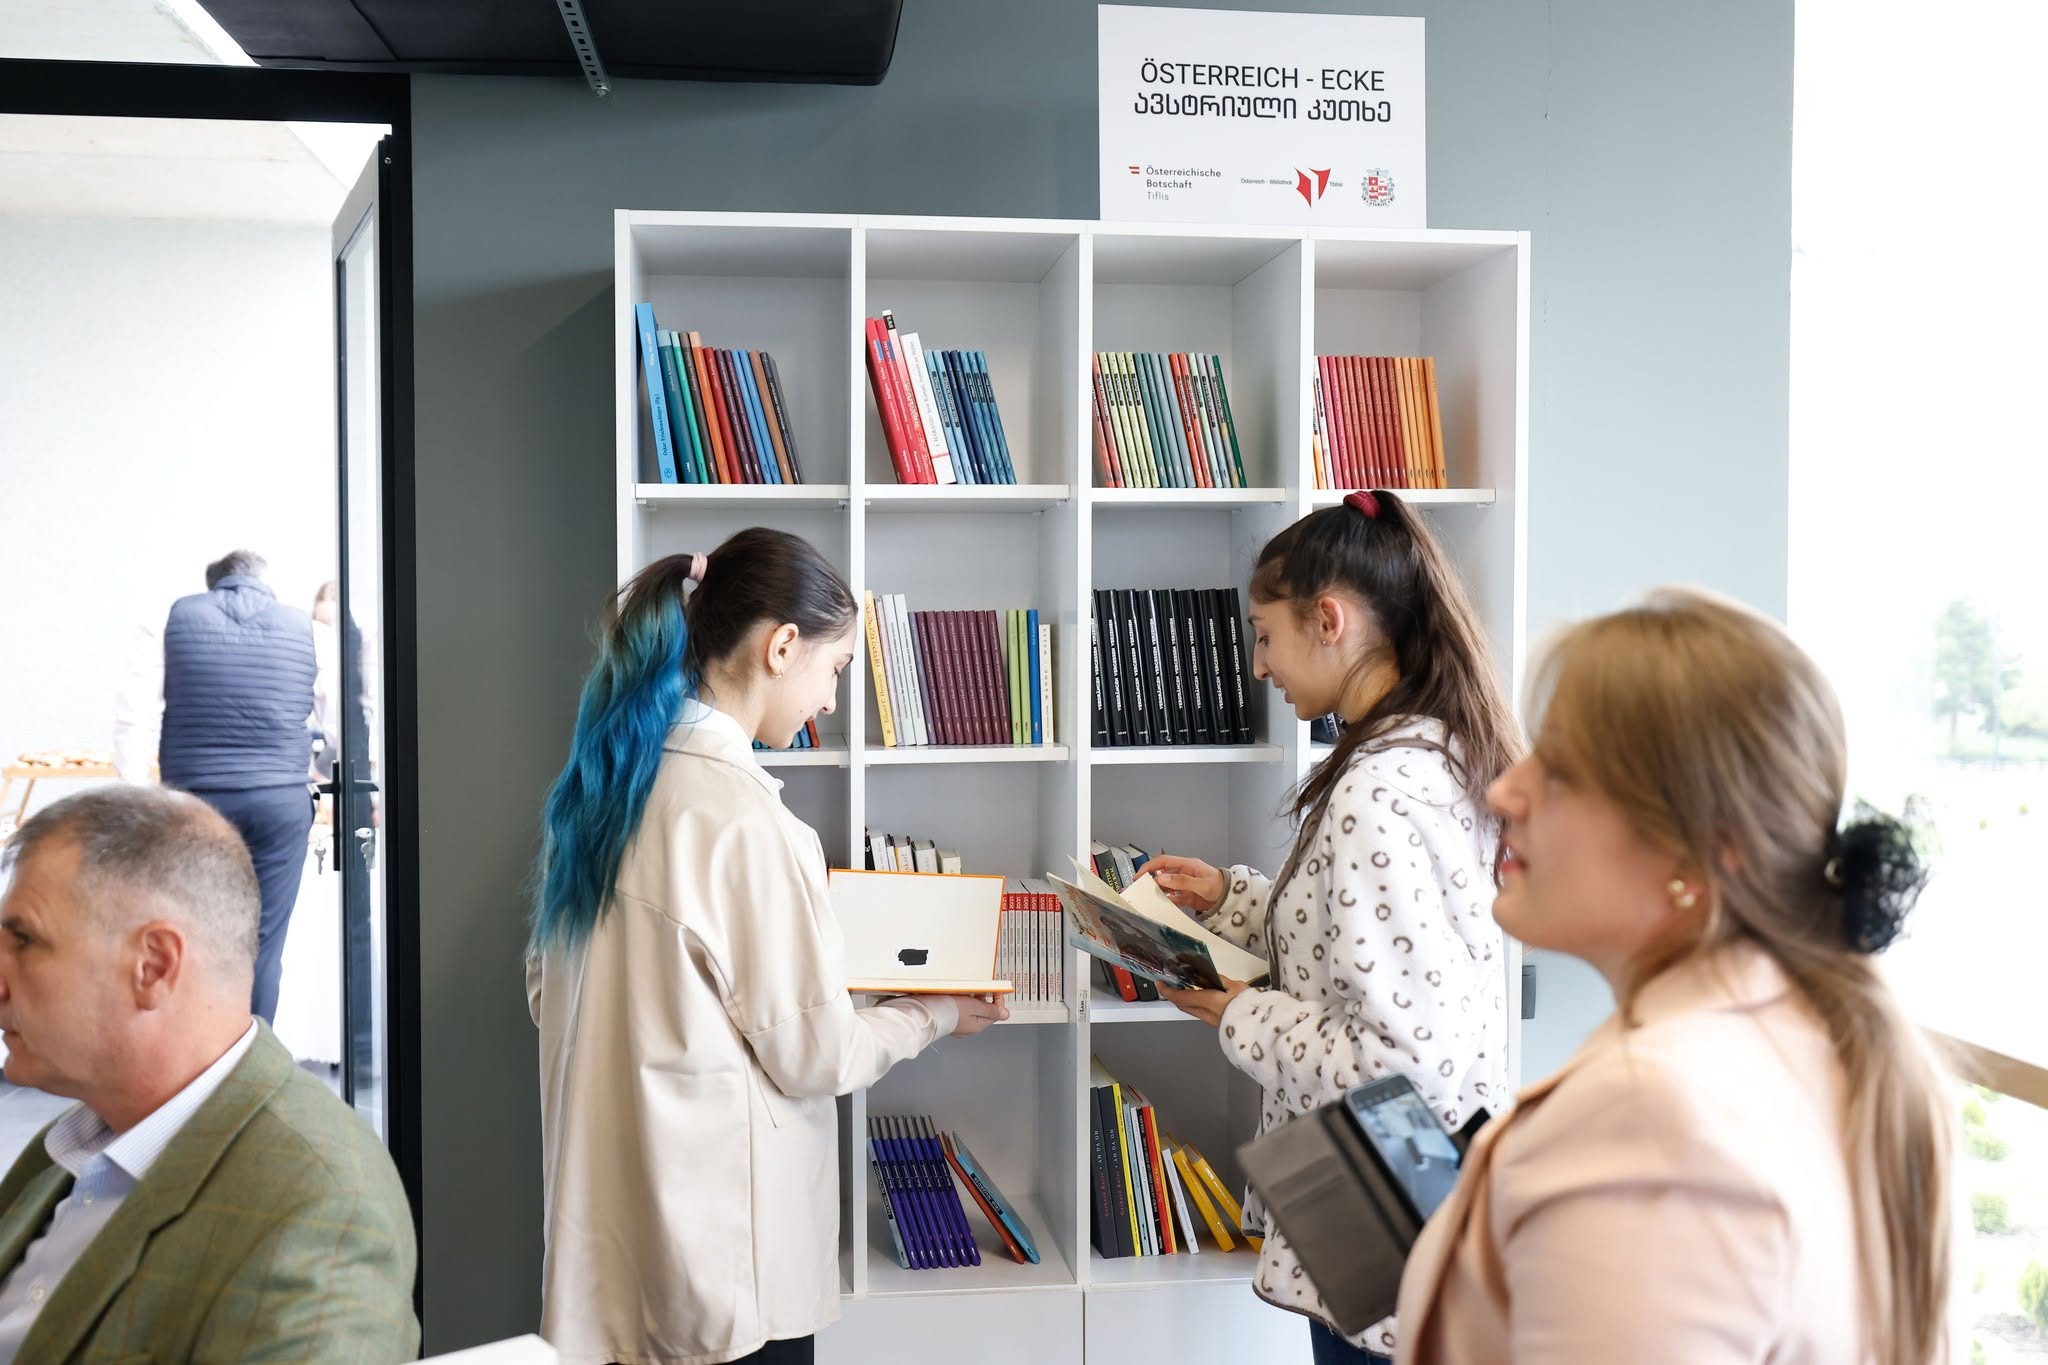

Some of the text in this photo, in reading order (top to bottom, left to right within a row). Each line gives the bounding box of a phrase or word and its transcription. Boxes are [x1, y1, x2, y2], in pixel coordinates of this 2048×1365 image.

[1141, 57, 1298, 88] ÖSTERREICH
[1322, 69, 1385, 91] ECKE
[1135, 92, 1391, 122] ავსტრიული კუთხე
[1146, 165, 1221, 177] Österreichische
[1146, 179, 1192, 189] Botschaft
[1147, 191, 1169, 200] Tiflis
